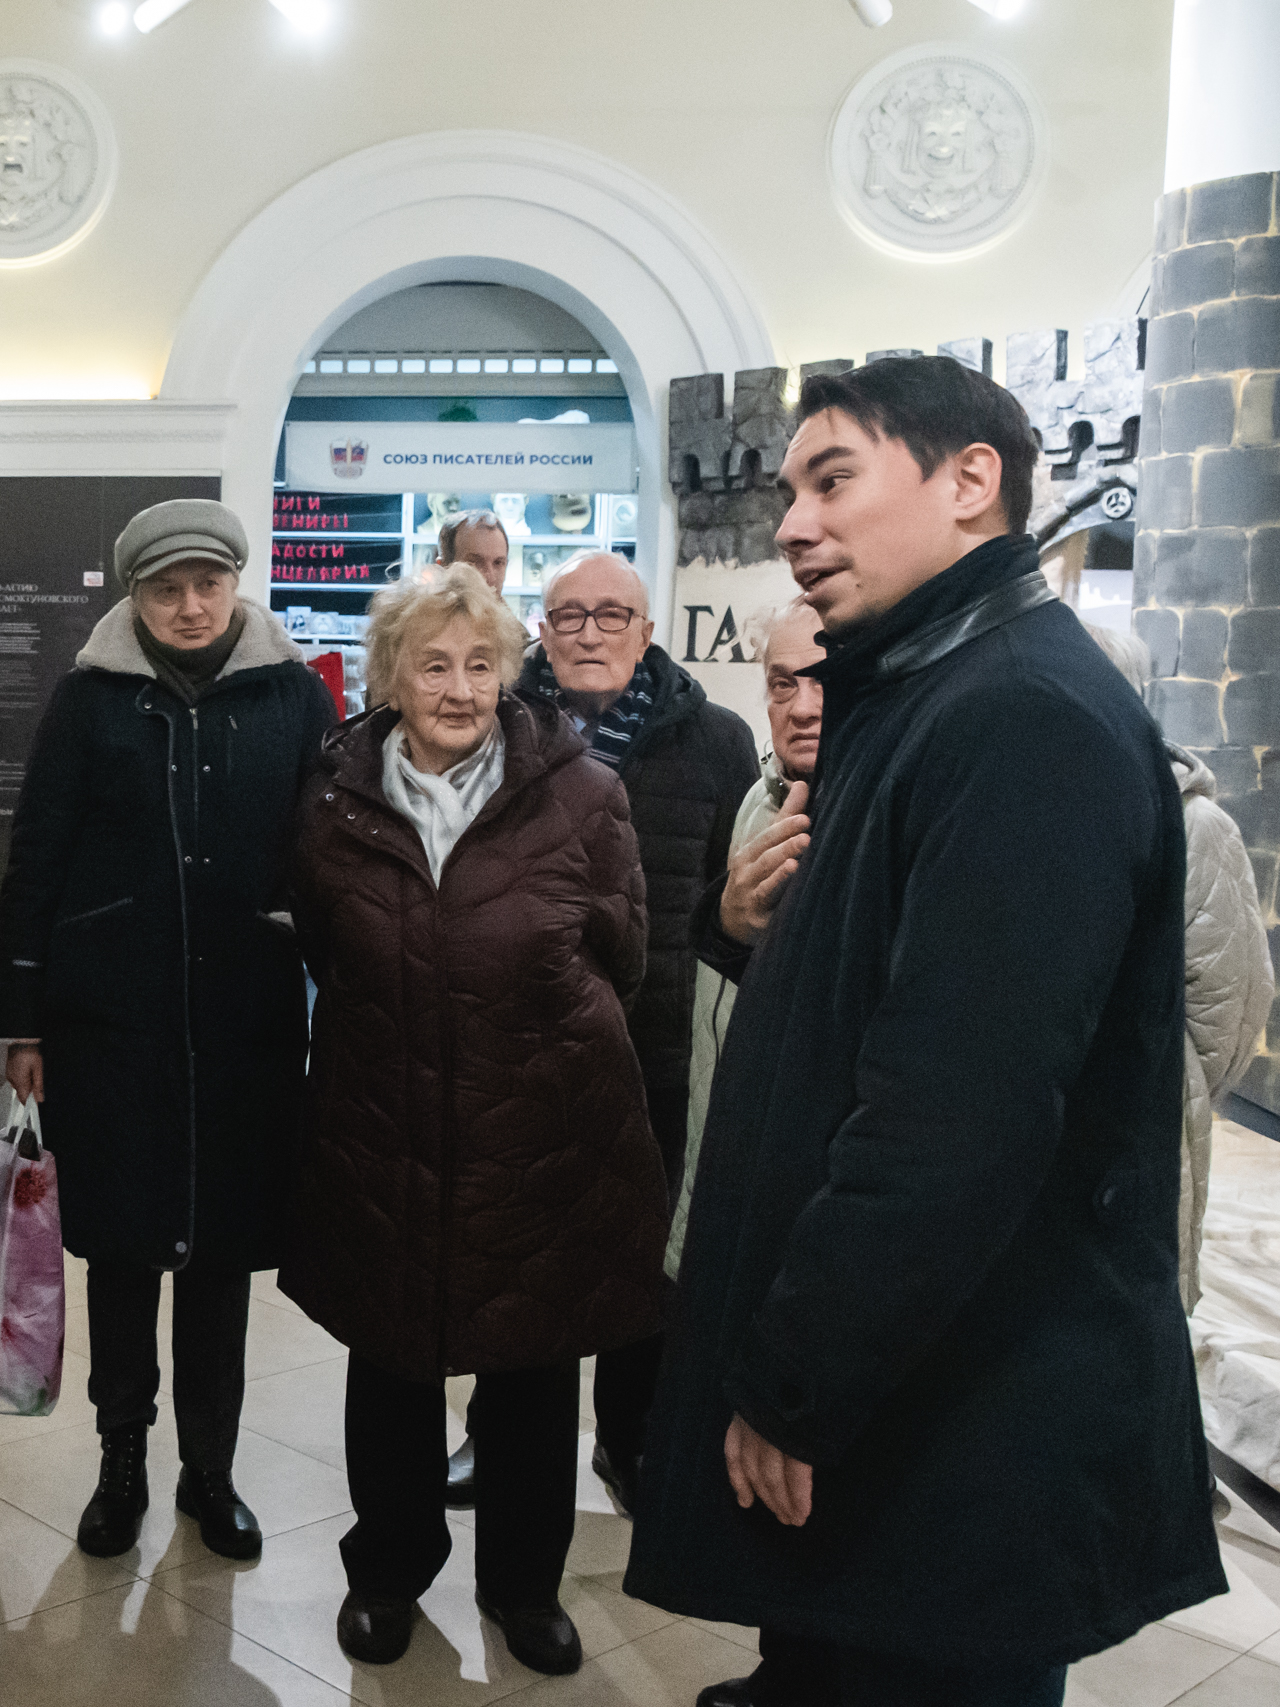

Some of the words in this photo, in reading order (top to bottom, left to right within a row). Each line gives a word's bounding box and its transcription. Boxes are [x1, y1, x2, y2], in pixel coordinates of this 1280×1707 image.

[383, 453, 428, 465] СОЮЗ
[433, 451, 524, 465] ПИСАТЕЛЕЙ
[529, 453, 593, 466] РОССИИ
[682, 605, 762, 663] ГА
